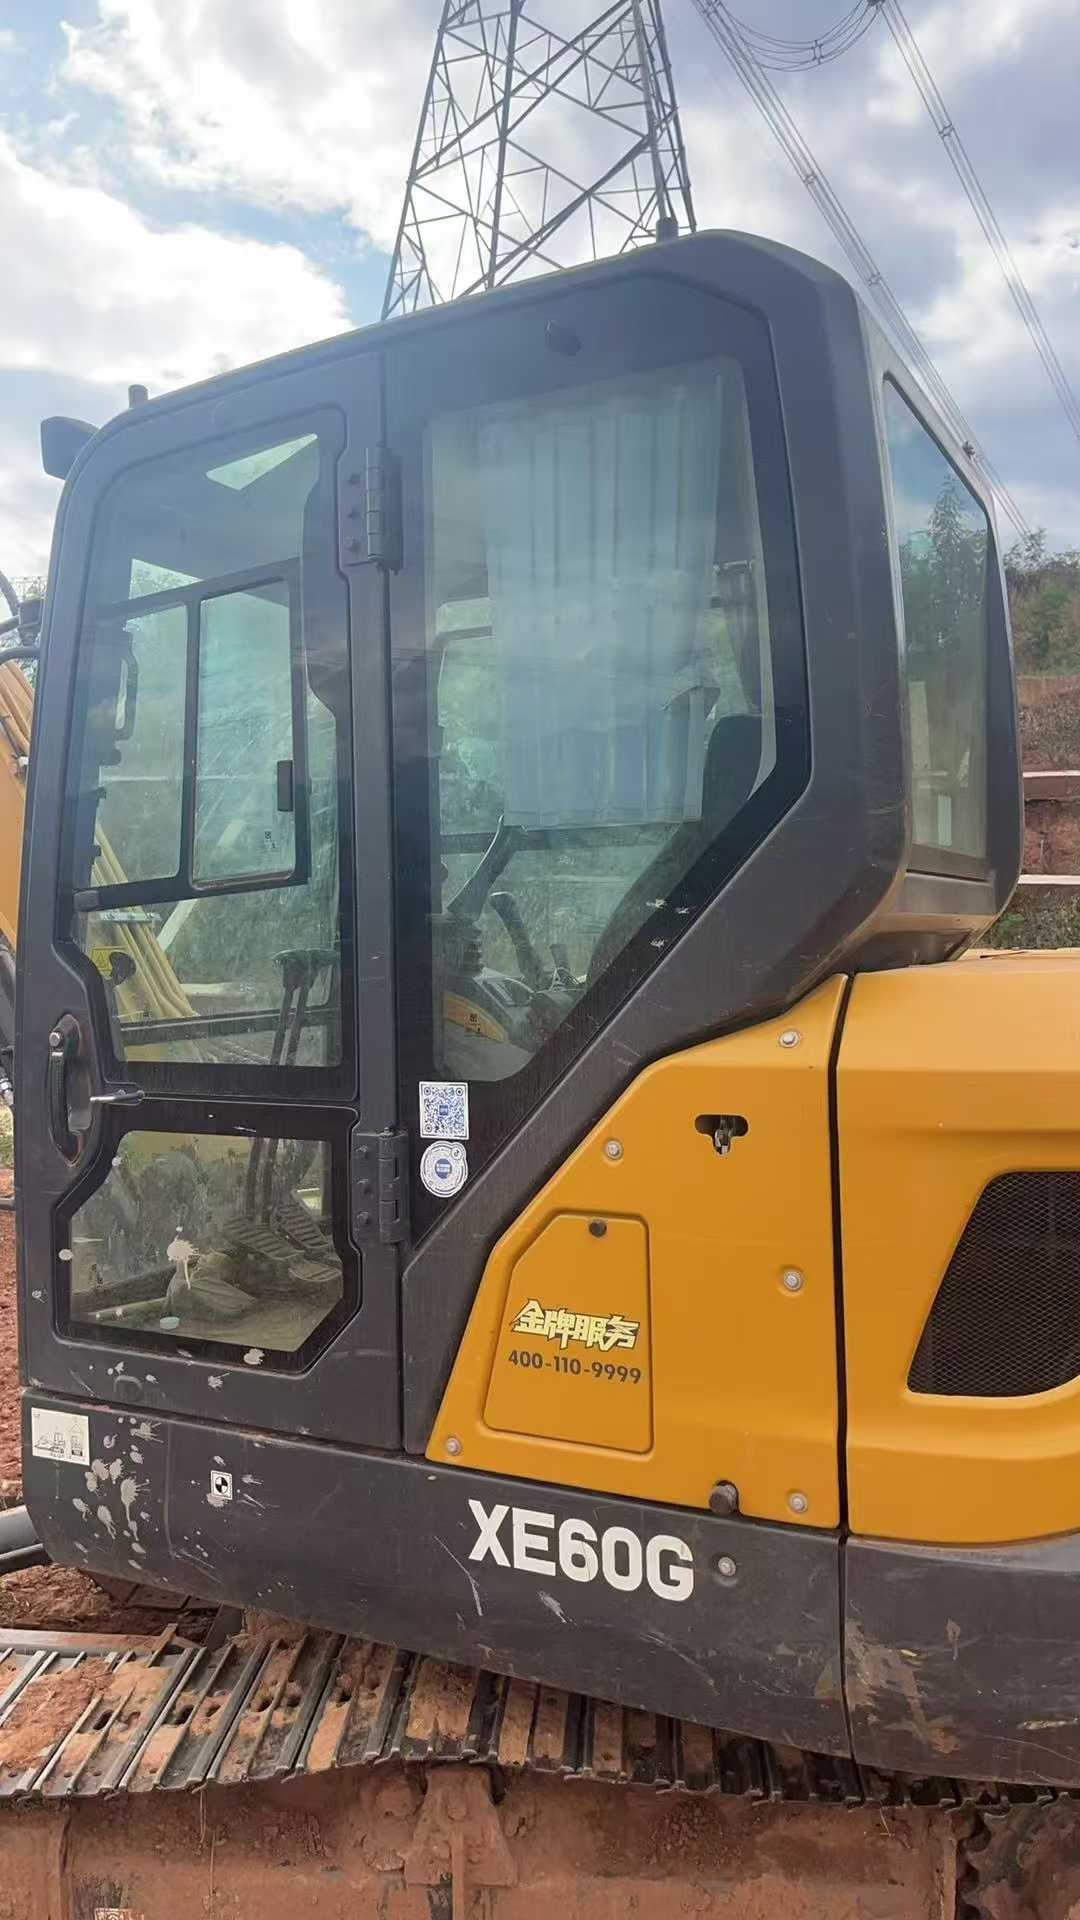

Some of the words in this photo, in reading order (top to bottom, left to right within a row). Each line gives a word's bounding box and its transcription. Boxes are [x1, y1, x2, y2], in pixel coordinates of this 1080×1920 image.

[510, 1299, 640, 1352] 金牌服务
[508, 1350, 641, 1384] 400-110-9999
[468, 1499, 694, 1601] XE60G
